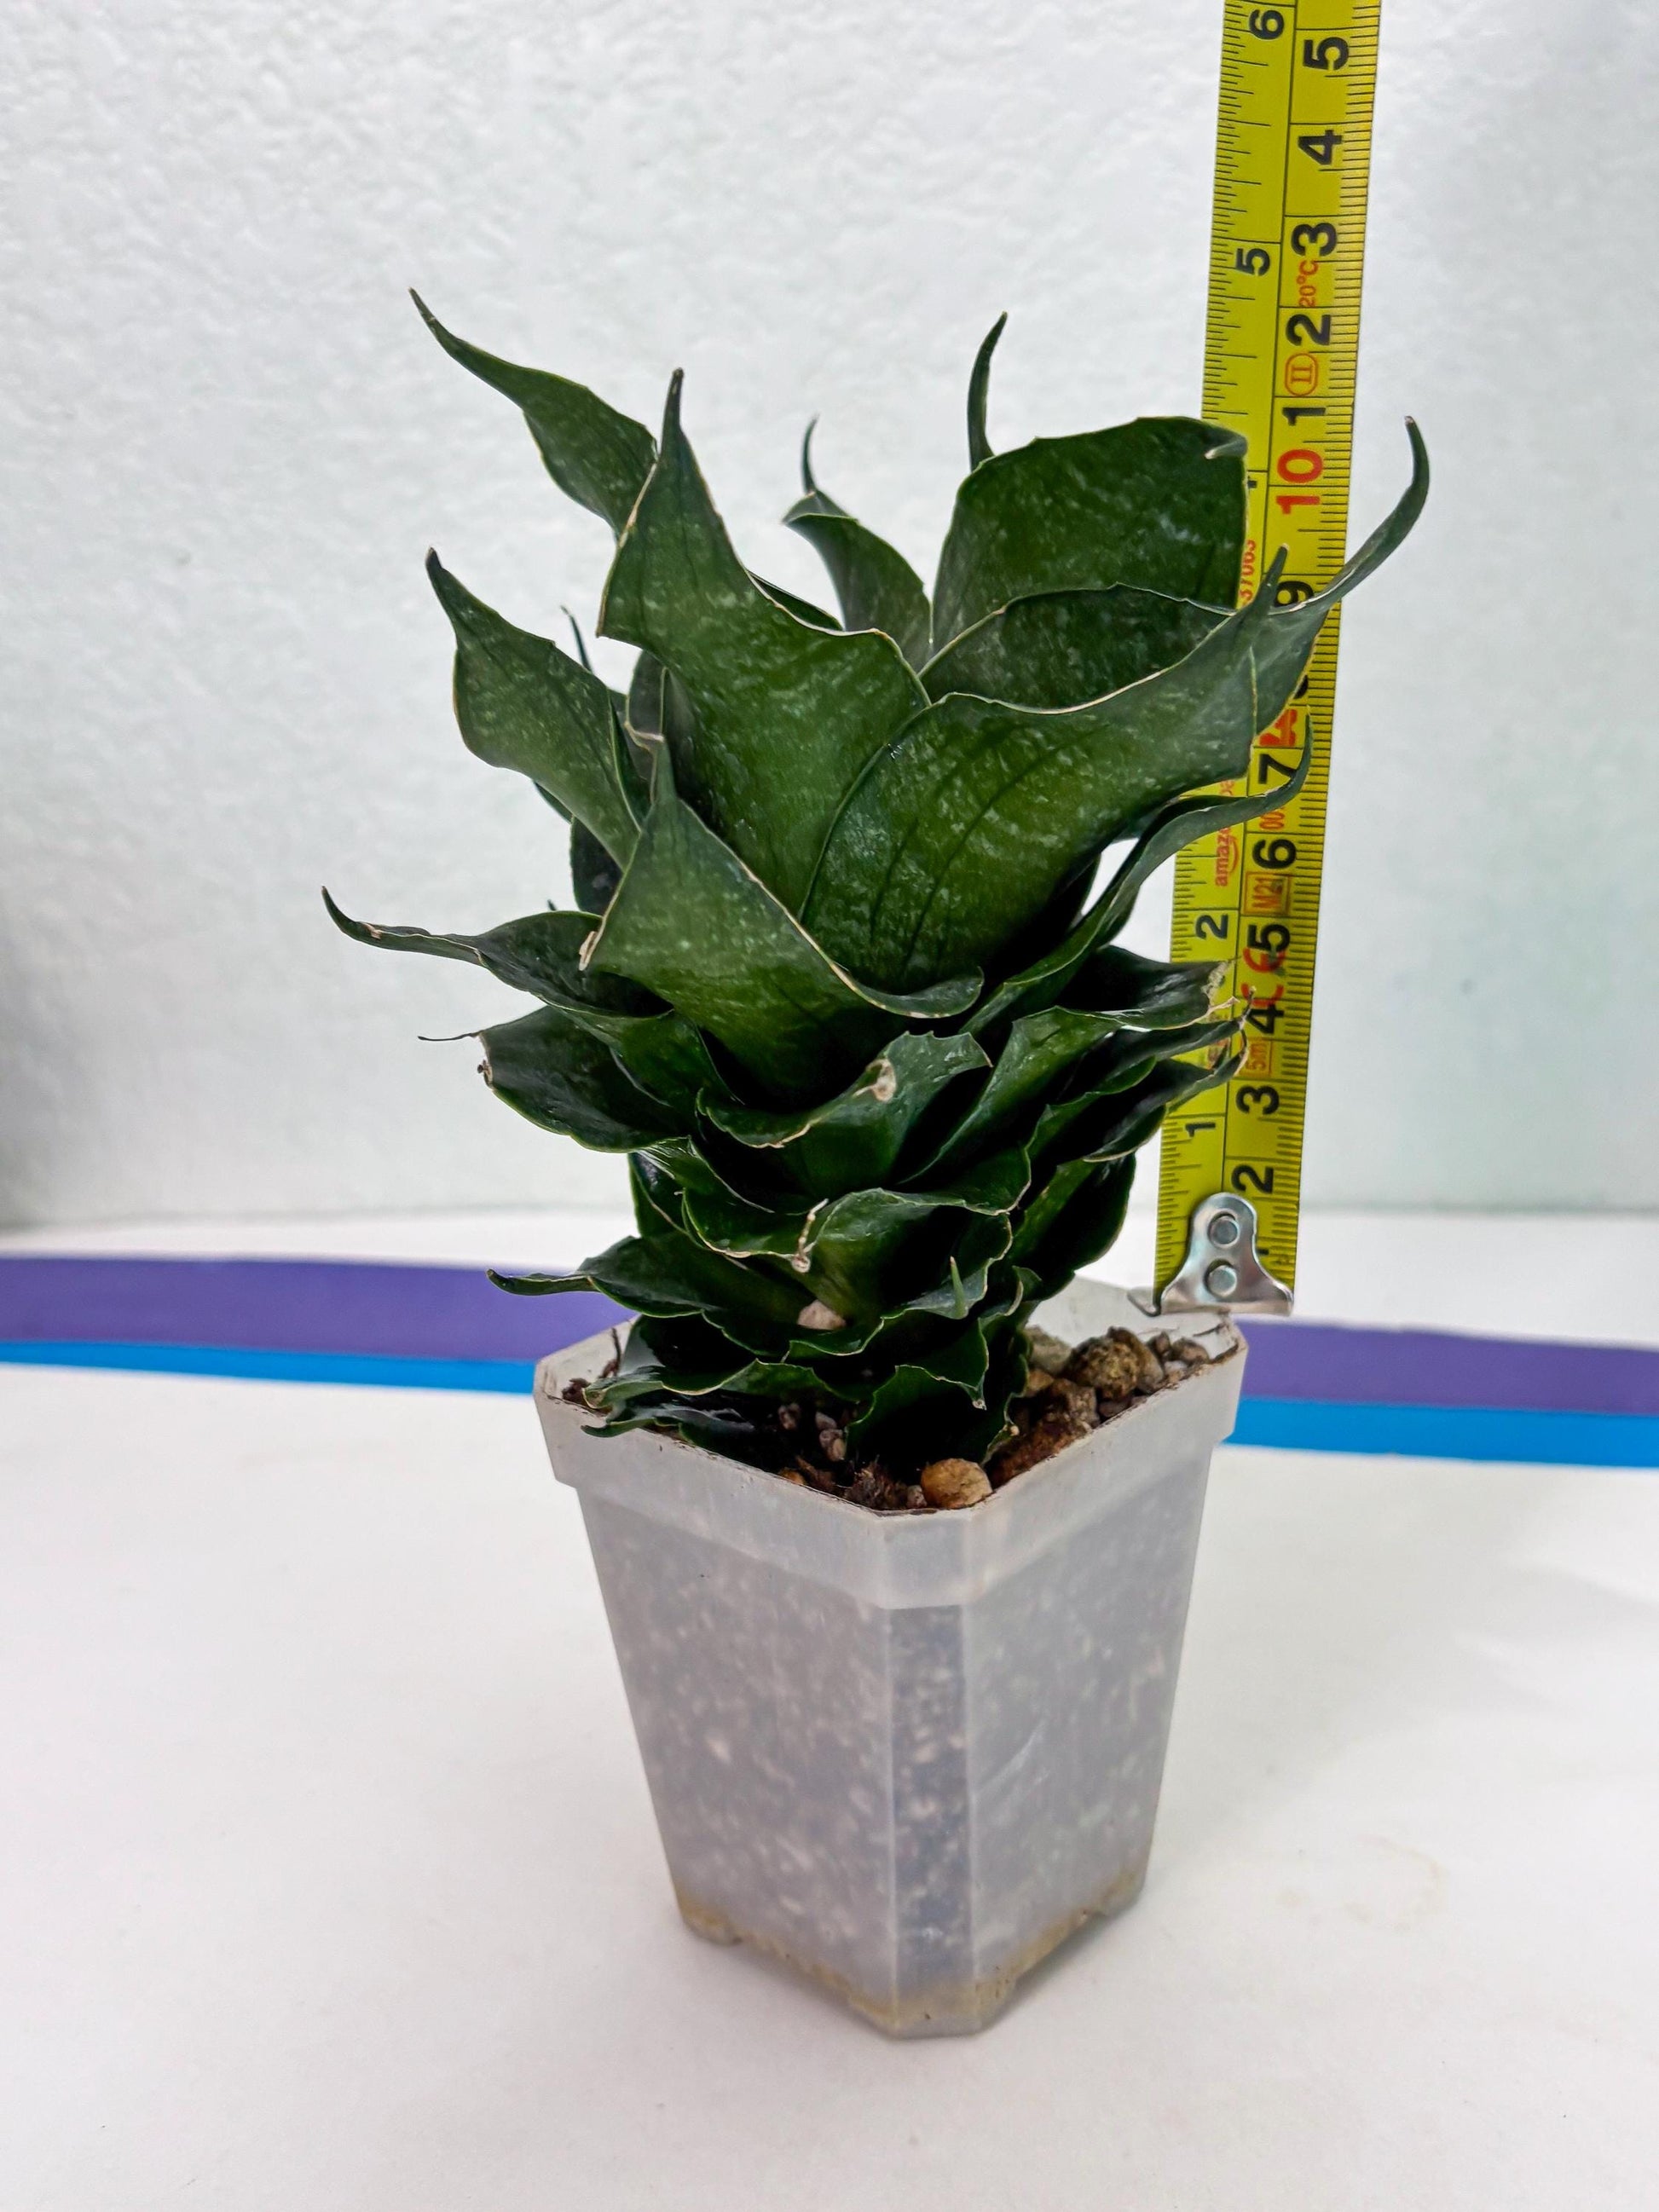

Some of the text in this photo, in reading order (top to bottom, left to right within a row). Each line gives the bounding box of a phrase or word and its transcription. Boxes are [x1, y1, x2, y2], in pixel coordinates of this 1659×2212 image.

[1249, 9, 1284, 39] 6
[1303, 37, 1349, 70] 5
[1298, 130, 1343, 165] 4
[1291, 222, 1337, 256] 3
[1236, 248, 1270, 276] 5
[1286, 314, 1332, 346] 2
[1281, 407, 1327, 426] 1
[1275, 449, 1323, 514] 10
[1274, 580, 1314, 607] 9
[1258, 754, 1298, 784] 7
[1252, 839, 1297, 869] 6
[1195, 914, 1229, 939] 2
[1247, 924, 1291, 952] 5
[1245, 1004, 1285, 1034] 4
[1236, 1085, 1280, 1114] 3
[1185, 1122, 1216, 1137] 1
[1231, 1164, 1275, 1194] 2
